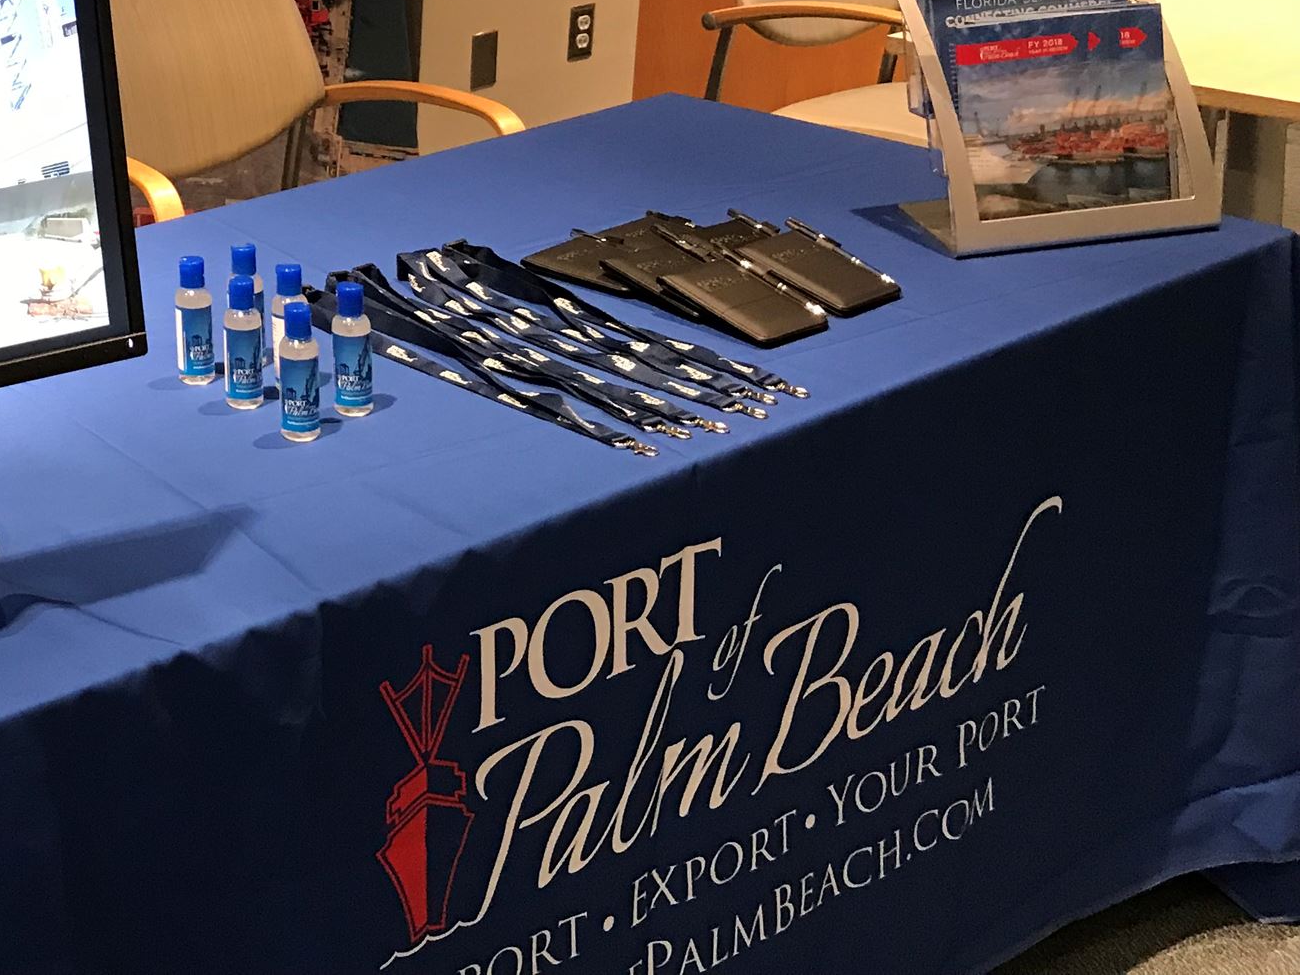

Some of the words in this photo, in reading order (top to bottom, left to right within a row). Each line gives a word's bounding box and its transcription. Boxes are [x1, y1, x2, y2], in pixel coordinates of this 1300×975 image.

[1027, 40, 1040, 49] FY
[469, 537, 722, 734] PORT
[707, 563, 782, 701] of
[474, 648, 751, 925] Palm
[751, 495, 1063, 796] Beach
[630, 809, 798, 928] EXPORT
[826, 744, 943, 827] YOUR
[956, 685, 1047, 769] PORT
